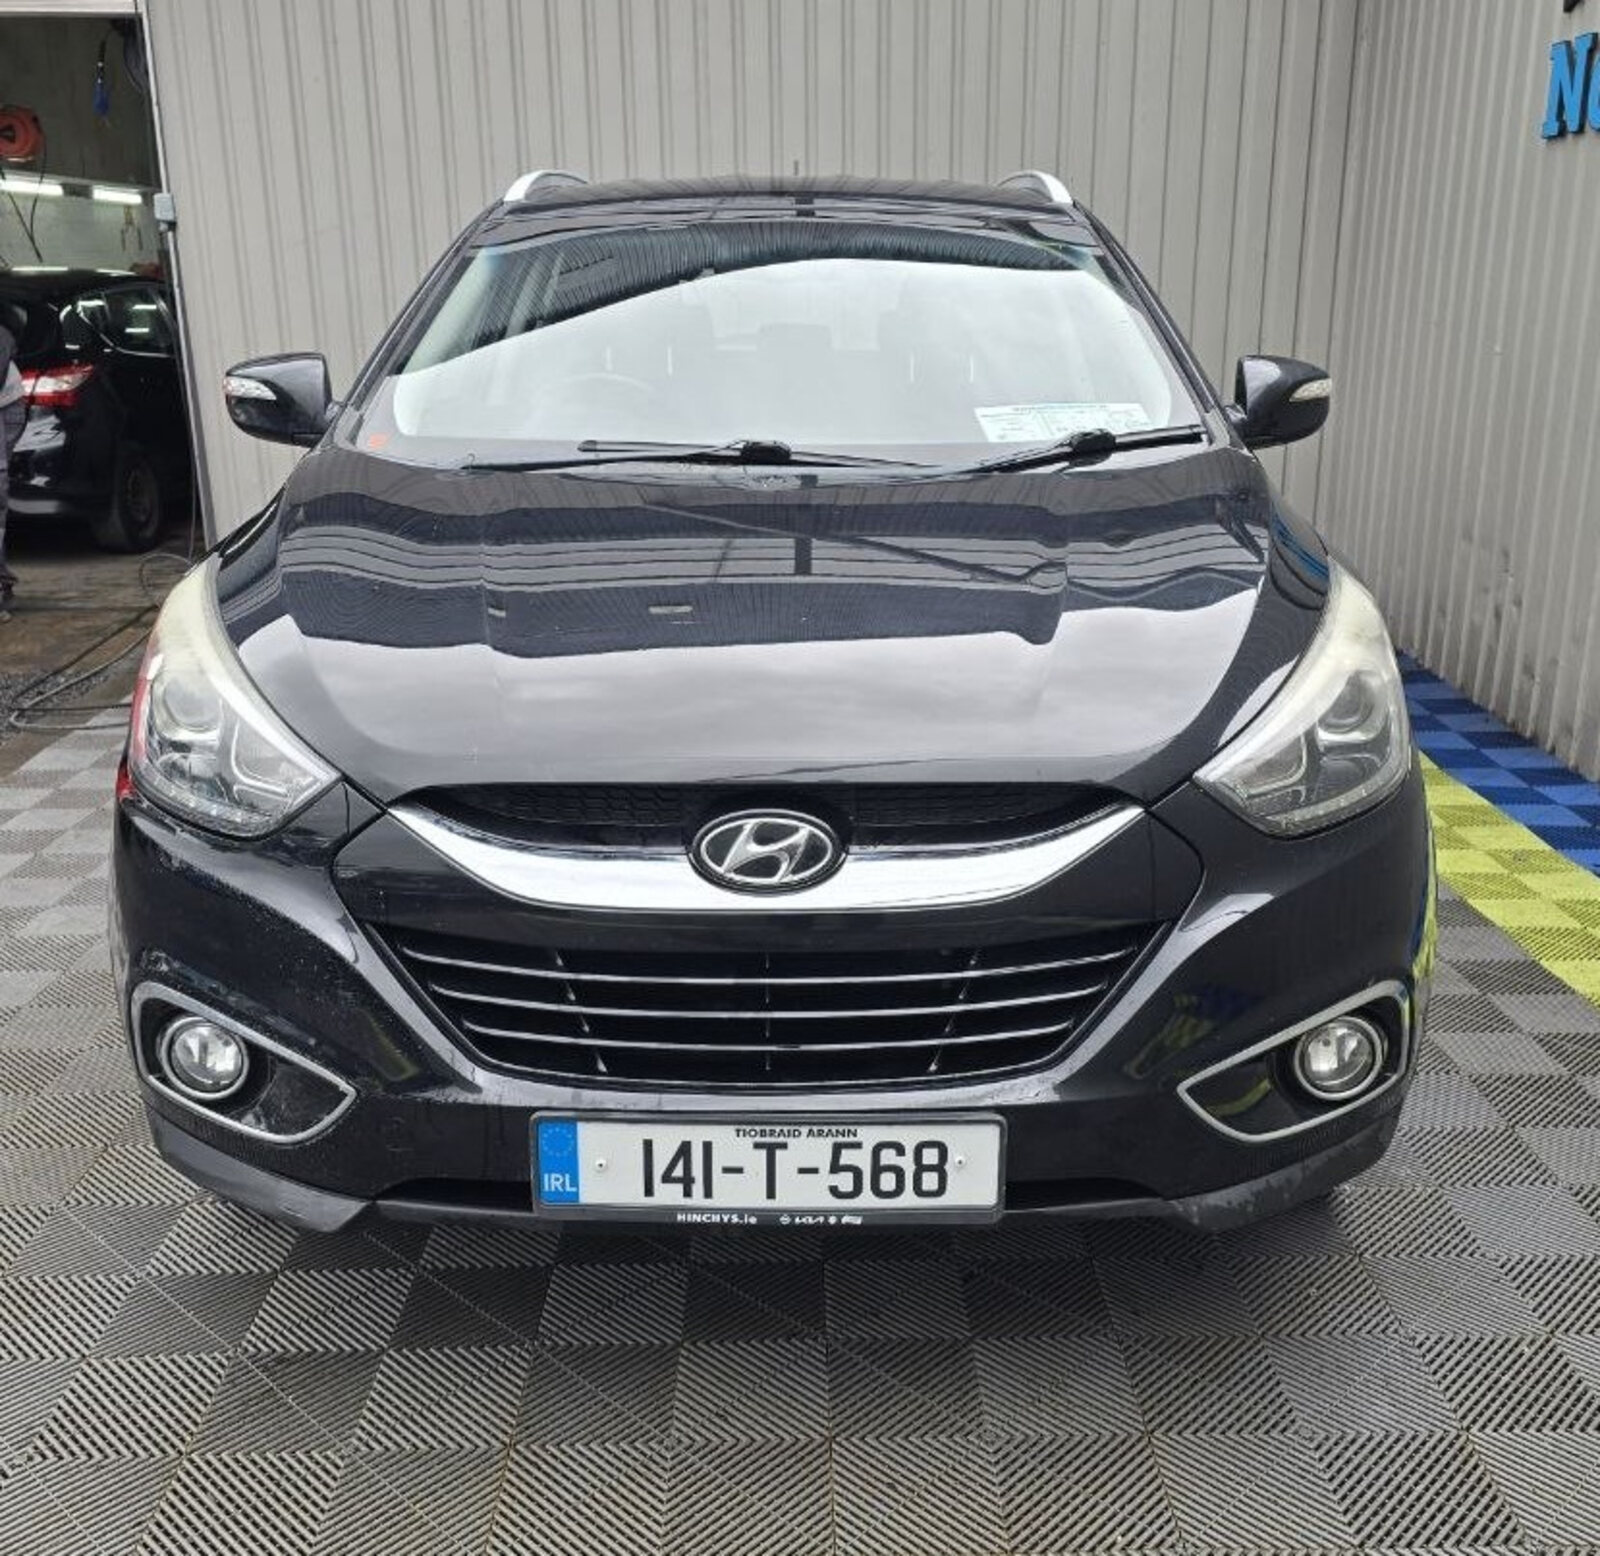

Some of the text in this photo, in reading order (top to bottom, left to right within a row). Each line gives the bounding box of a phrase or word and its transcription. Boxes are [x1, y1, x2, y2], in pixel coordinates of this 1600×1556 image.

[735, 1128, 801, 1138] TIOBRAID
[642, 1138, 949, 1200] 141-T-568
[543, 1173, 577, 1193] IRL
